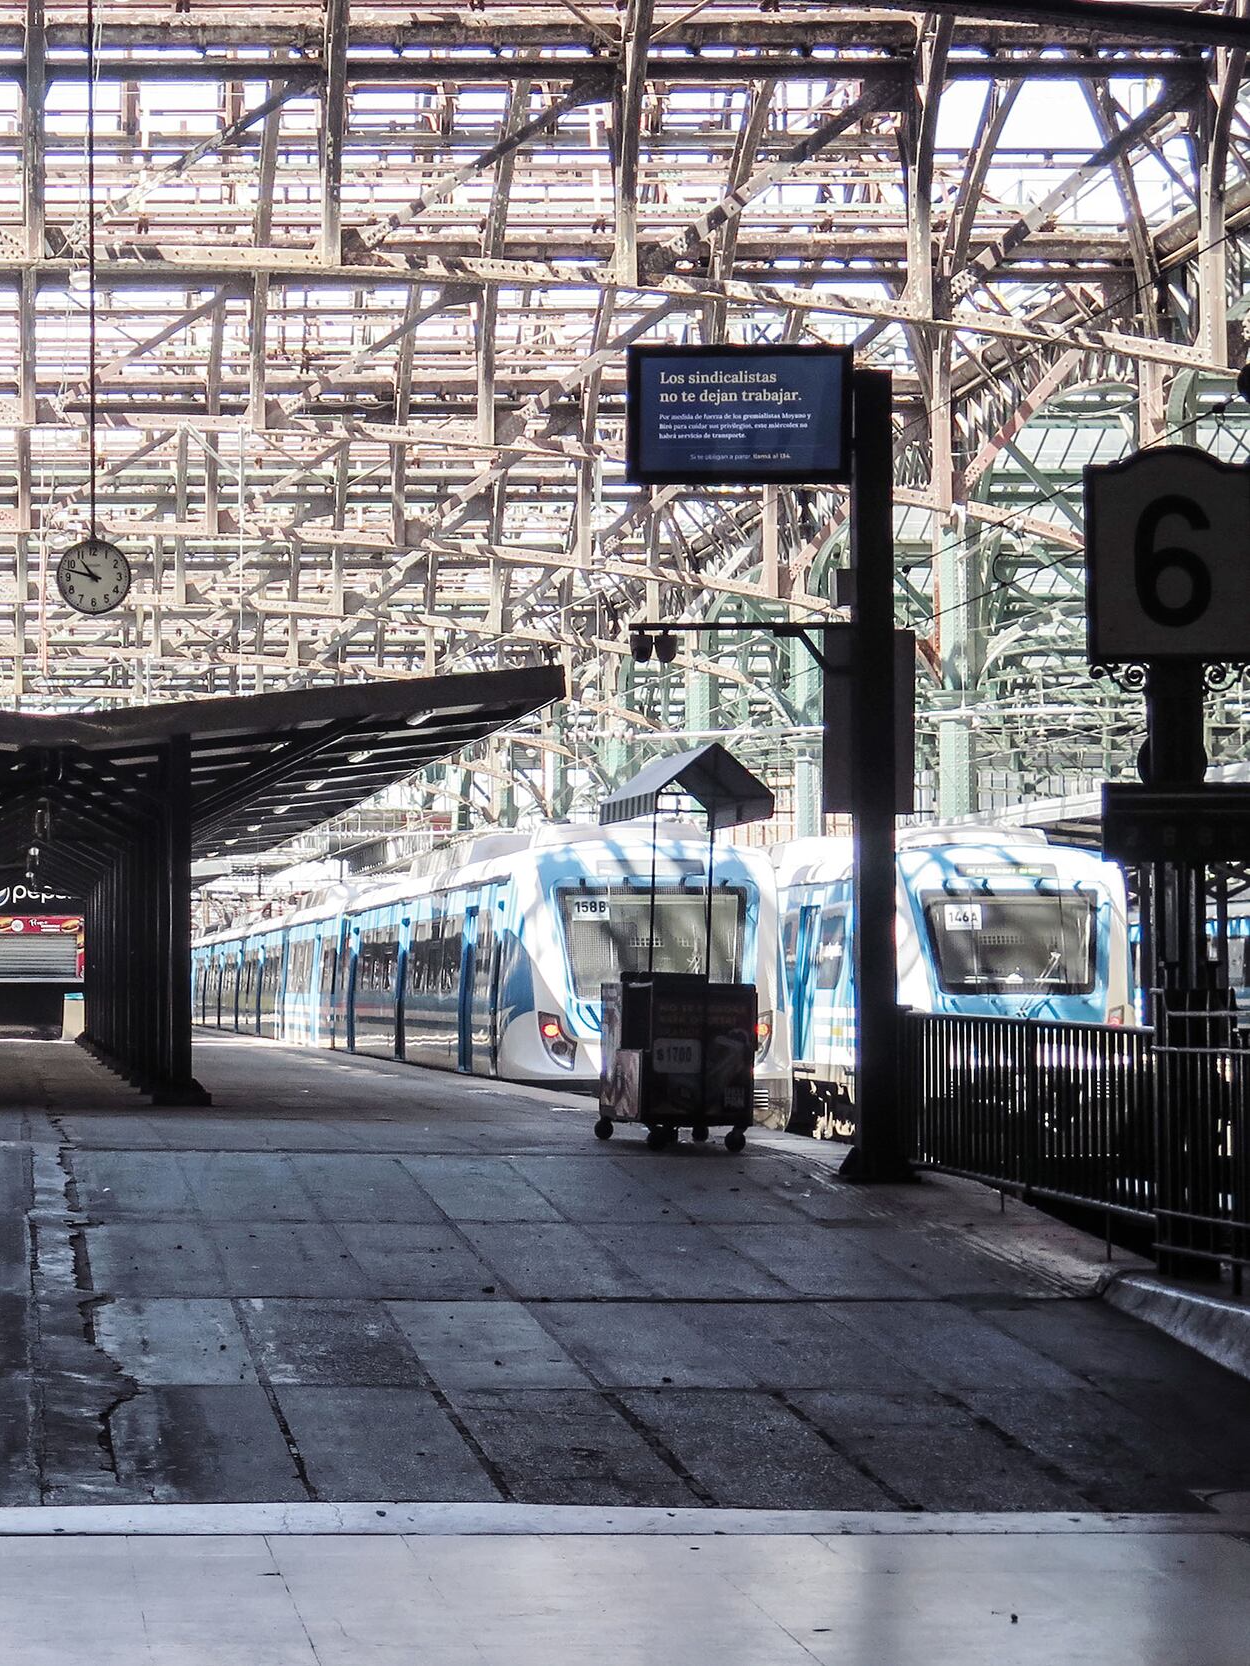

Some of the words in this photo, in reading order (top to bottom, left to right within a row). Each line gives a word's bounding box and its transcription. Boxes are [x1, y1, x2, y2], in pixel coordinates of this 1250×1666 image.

[660, 372, 685, 384] Los
[688, 371, 777, 384] sindicalistas
[660, 393, 678, 402] no
[681, 391, 695, 402] te
[699, 389, 738, 405] dejan
[742, 388, 802, 405] trabajar.
[77, 551, 84, 559] 11
[89, 548, 97, 556] 12
[67, 560, 75, 569] 10
[113, 560, 119, 568] 2
[1134, 494, 1212, 628] 6
[65, 573, 71, 582] 9
[117, 573, 122, 581] 3
[69, 585, 75, 594] 8
[112, 585, 119, 594] 4
[78, 594, 84, 604] 7
[91, 598, 97, 607] 6
[104, 594, 109, 603] 5
[12, 885, 72, 904] pep
[575, 901, 606, 912] 158B
